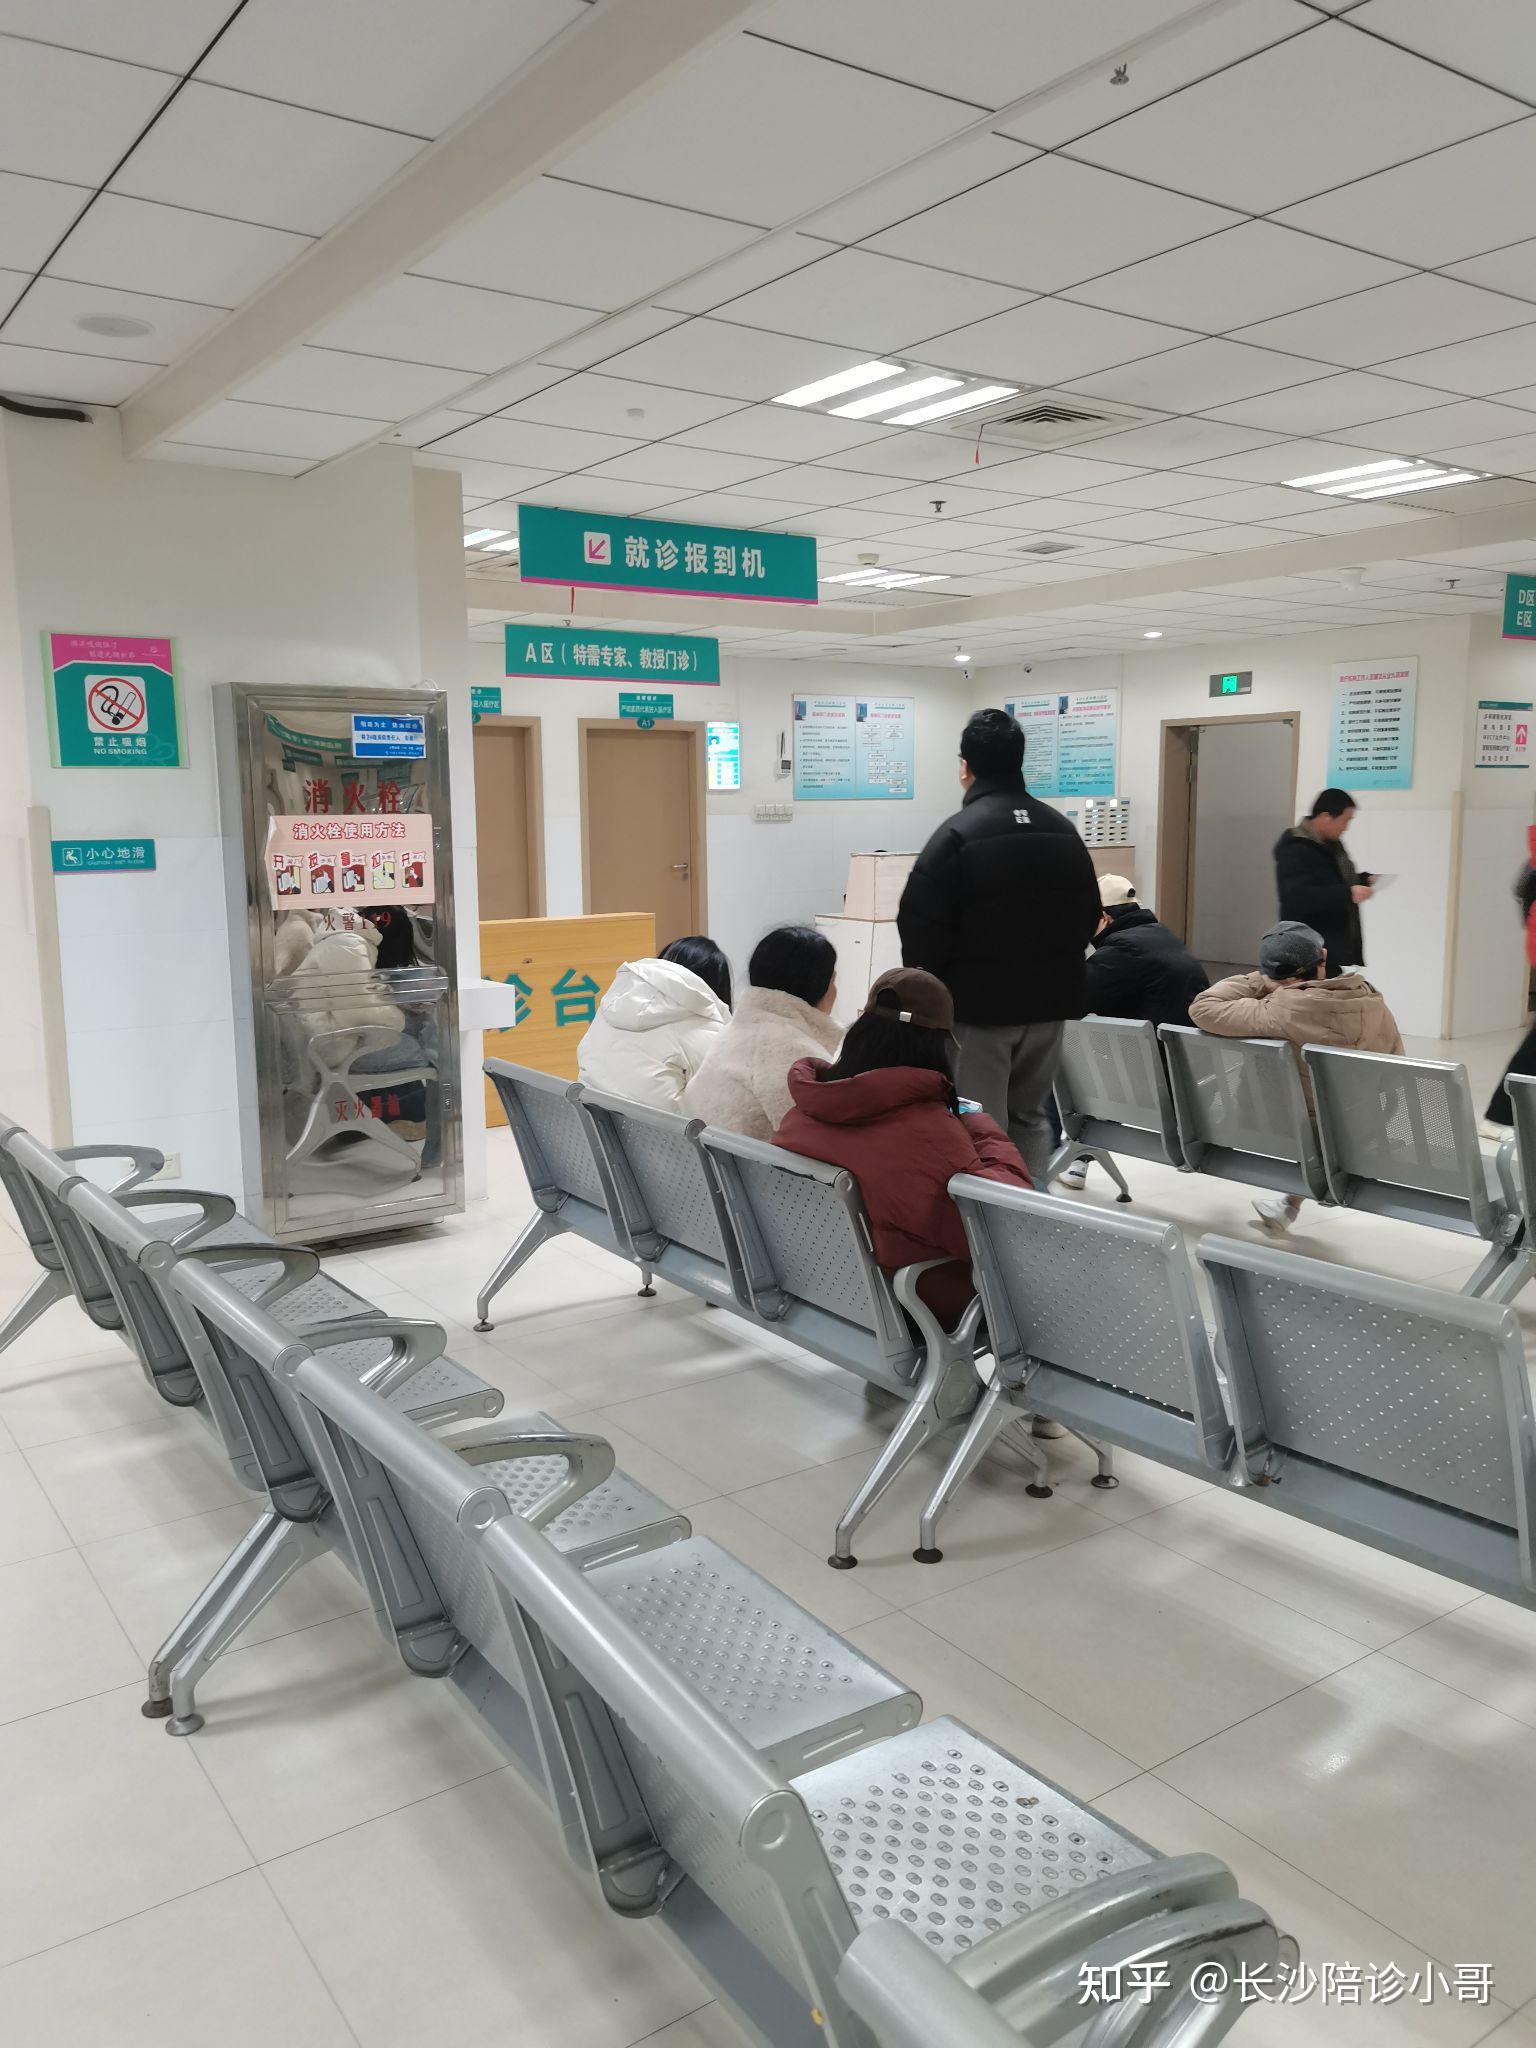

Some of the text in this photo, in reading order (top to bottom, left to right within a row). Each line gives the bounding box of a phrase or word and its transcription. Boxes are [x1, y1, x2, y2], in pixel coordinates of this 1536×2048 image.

[624, 535, 765, 579] 就诊报到机
[1518, 589, 1535, 606] D区
[1516, 611, 1533, 627] E区
[94, 736, 147, 747] 禁止吸烟
[305, 778, 401, 814] 消火栓
[293, 822, 406, 840] 消火栓使用方法
[86, 846, 145, 859] 小心地滑
[324, 912, 392, 931] 火警119
